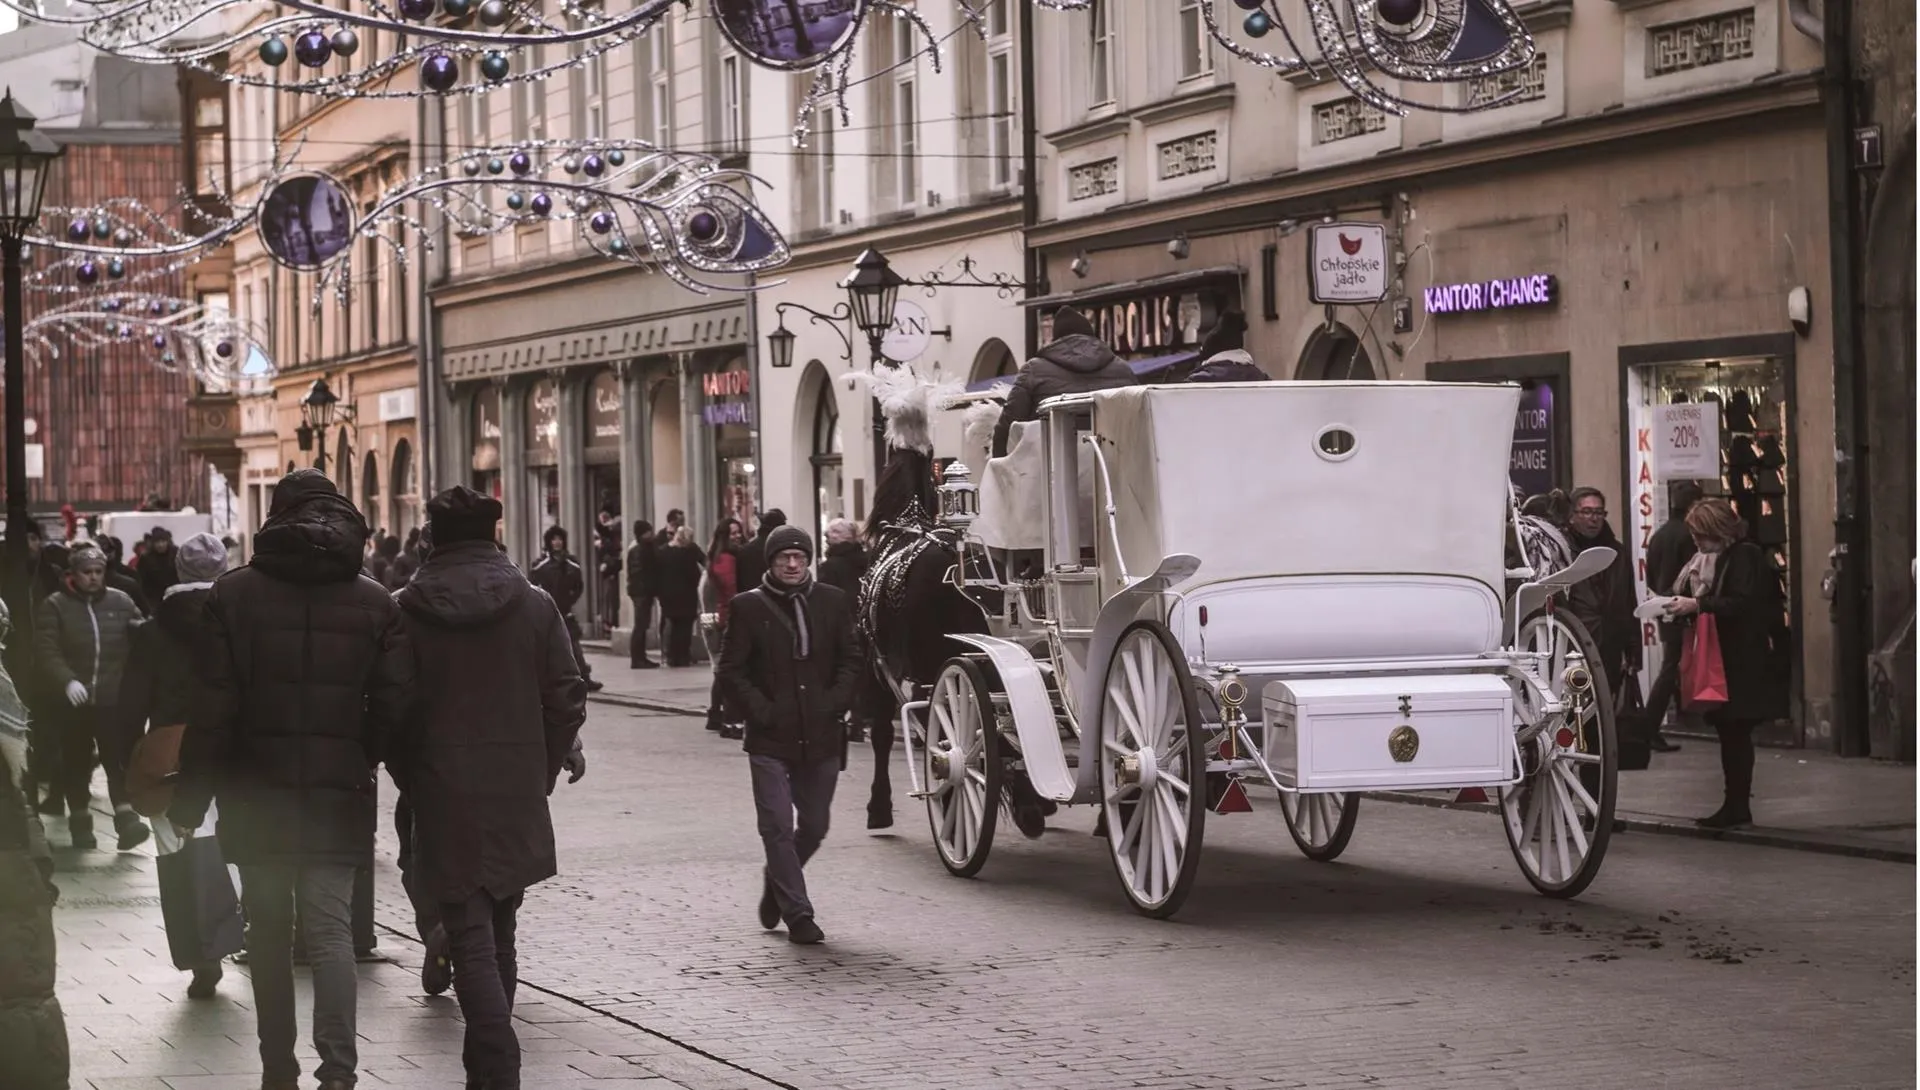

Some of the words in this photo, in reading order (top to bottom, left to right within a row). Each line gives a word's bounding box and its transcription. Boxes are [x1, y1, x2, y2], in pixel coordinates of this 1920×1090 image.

[1320, 256, 1380, 274] Chłopskie
[1333, 271, 1366, 289] jadło
[1669, 425, 1700, 449] -20%
[1509, 448, 1547, 470] HANGE
